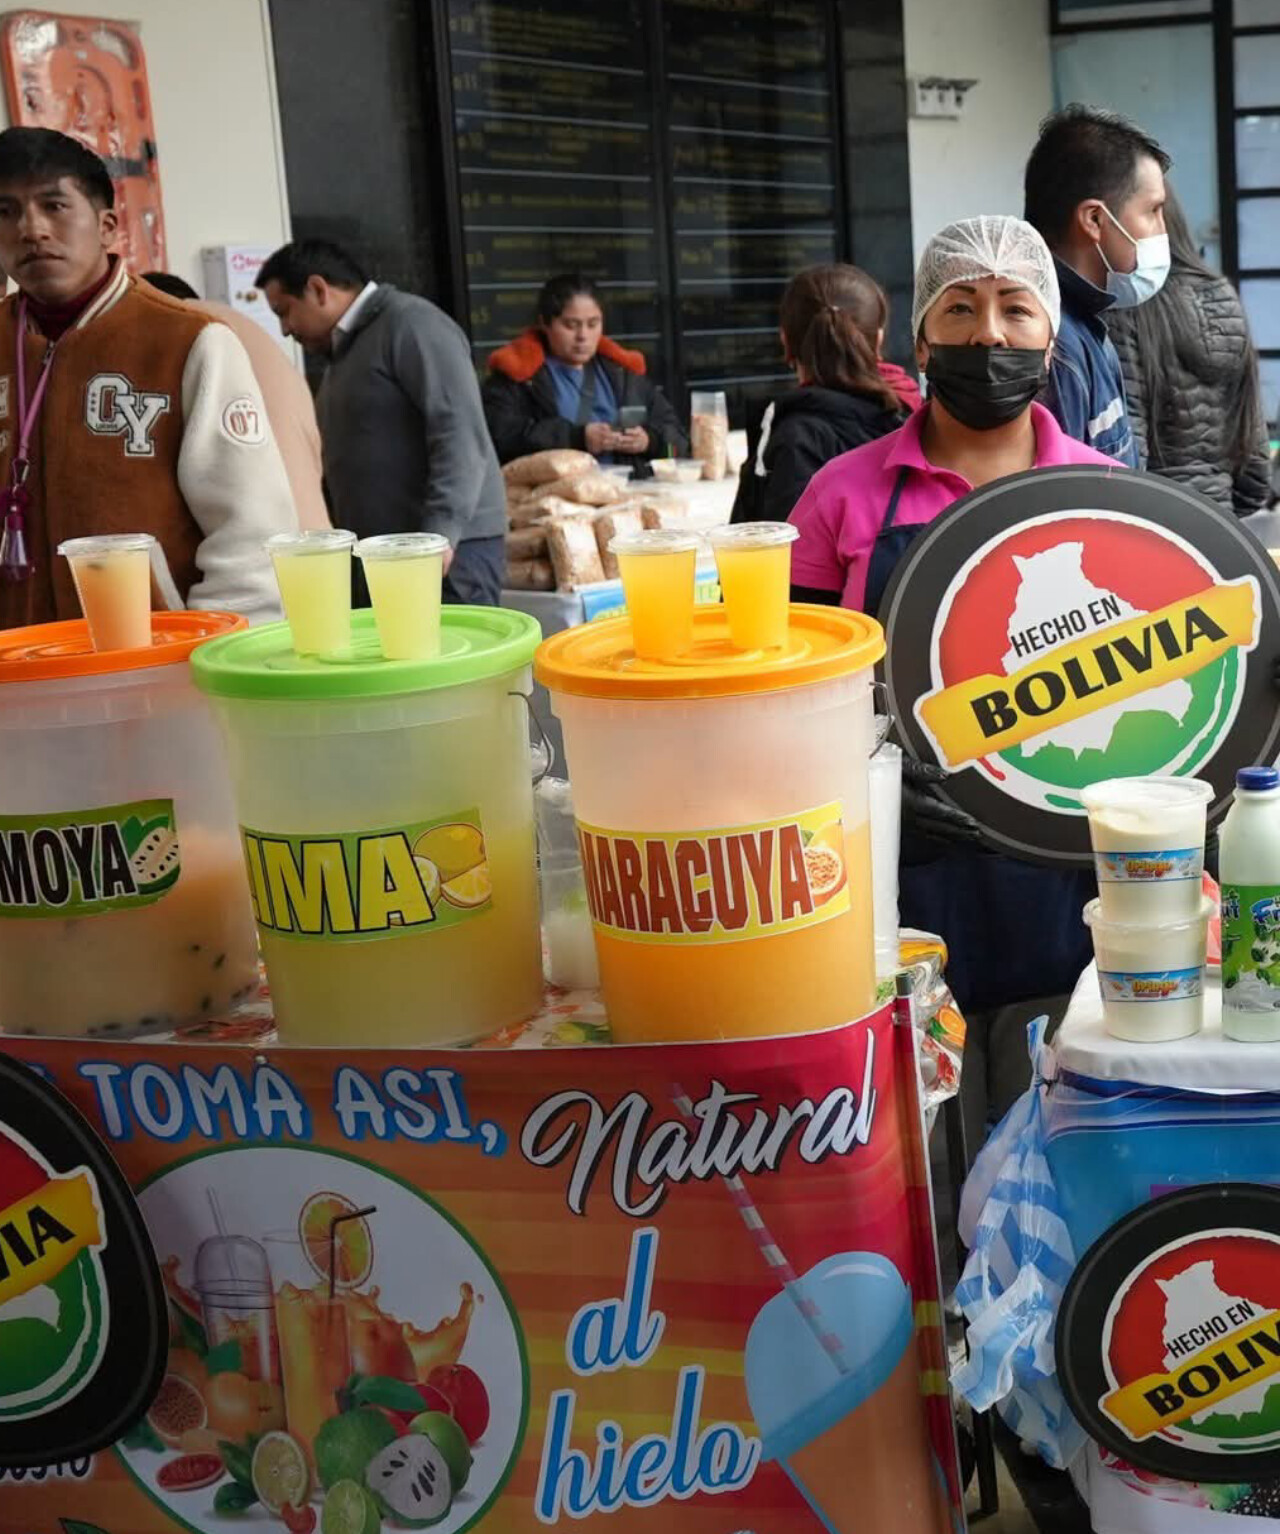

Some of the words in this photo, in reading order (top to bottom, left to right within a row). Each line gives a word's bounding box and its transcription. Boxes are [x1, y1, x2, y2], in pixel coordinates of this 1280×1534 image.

[229, 411, 259, 436] 07
[970, 605, 1229, 739] BOLIVIA
[1010, 608, 1088, 658] HECHO
[1087, 594, 1122, 625] EN
[246, 831, 436, 935] IMA
[78, 1062, 306, 1140] TOMA
[334, 1065, 500, 1155] ASI,
[519, 1027, 877, 1219] Natural
[569, 1229, 663, 1374] al
[1166, 1316, 1228, 1359] HECHO
[1225, 1300, 1256, 1327] EN
[537, 1367, 760, 1522] hielo
